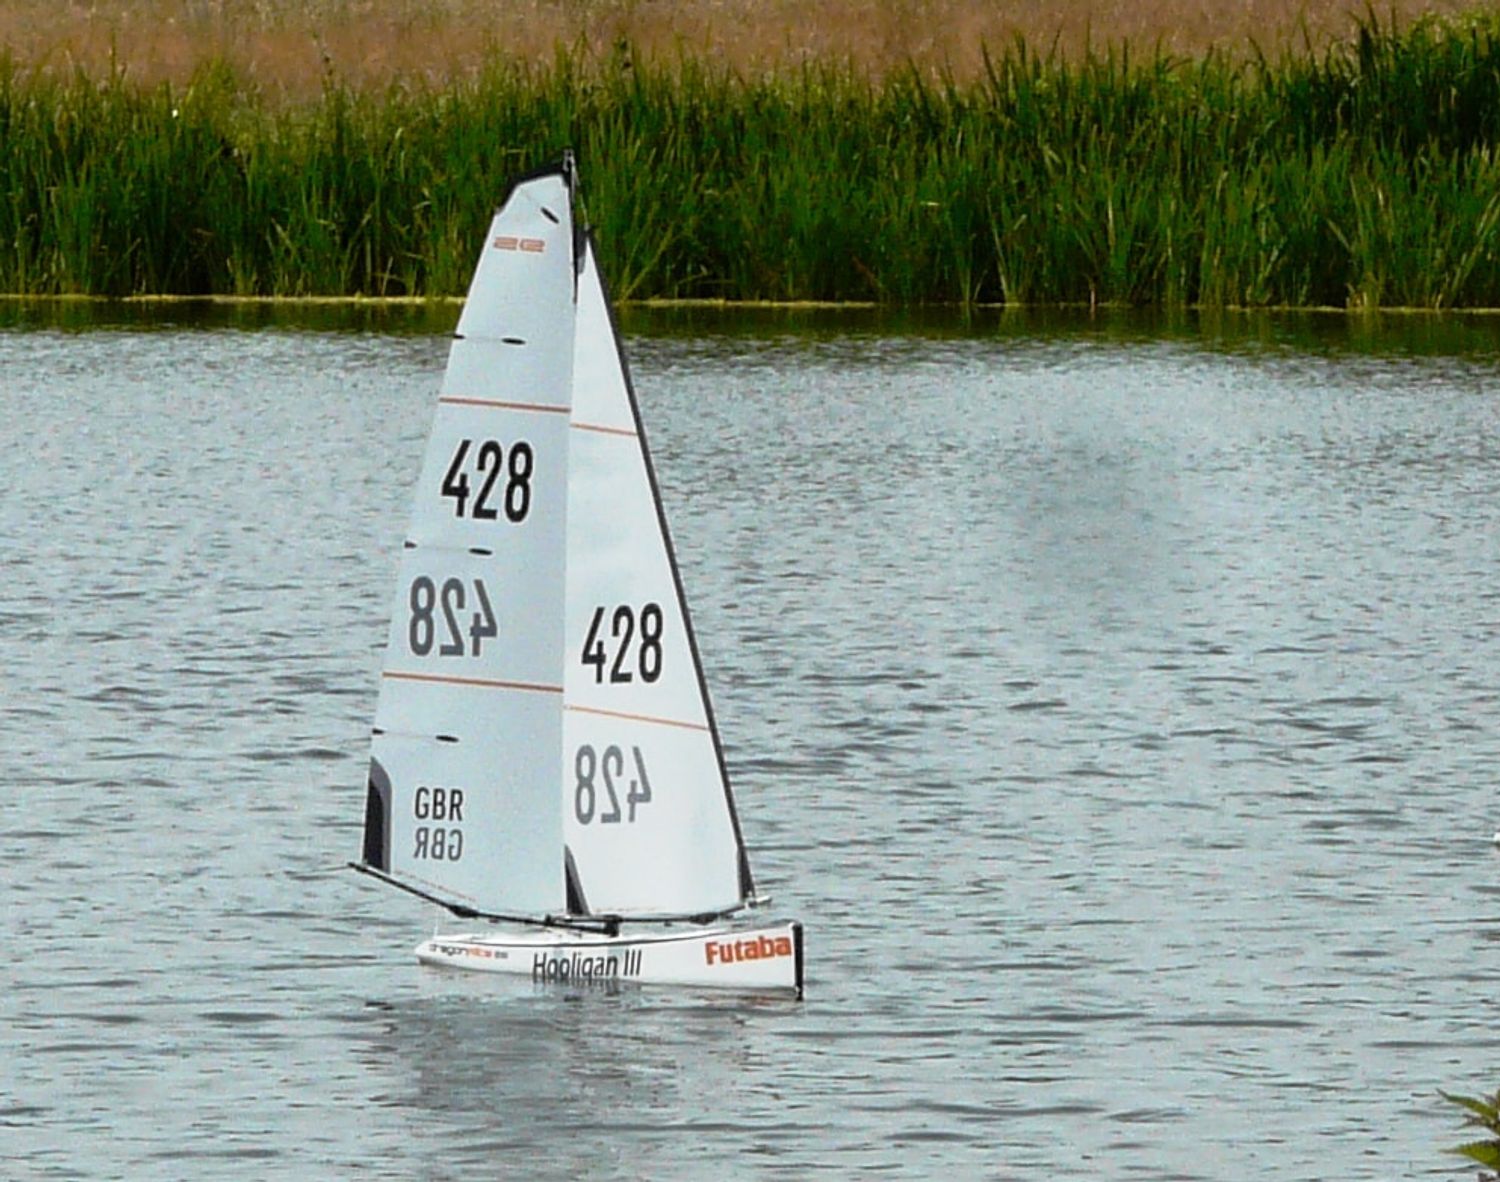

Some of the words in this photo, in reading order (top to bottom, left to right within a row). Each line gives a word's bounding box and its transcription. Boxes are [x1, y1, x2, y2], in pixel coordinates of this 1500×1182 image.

[441, 439, 533, 523] 428
[581, 602, 663, 684] 428
[414, 786, 464, 822] GBR
[533, 951, 619, 982] Hooligan
[623, 948, 642, 976] III
[705, 935, 792, 966] Futaba
